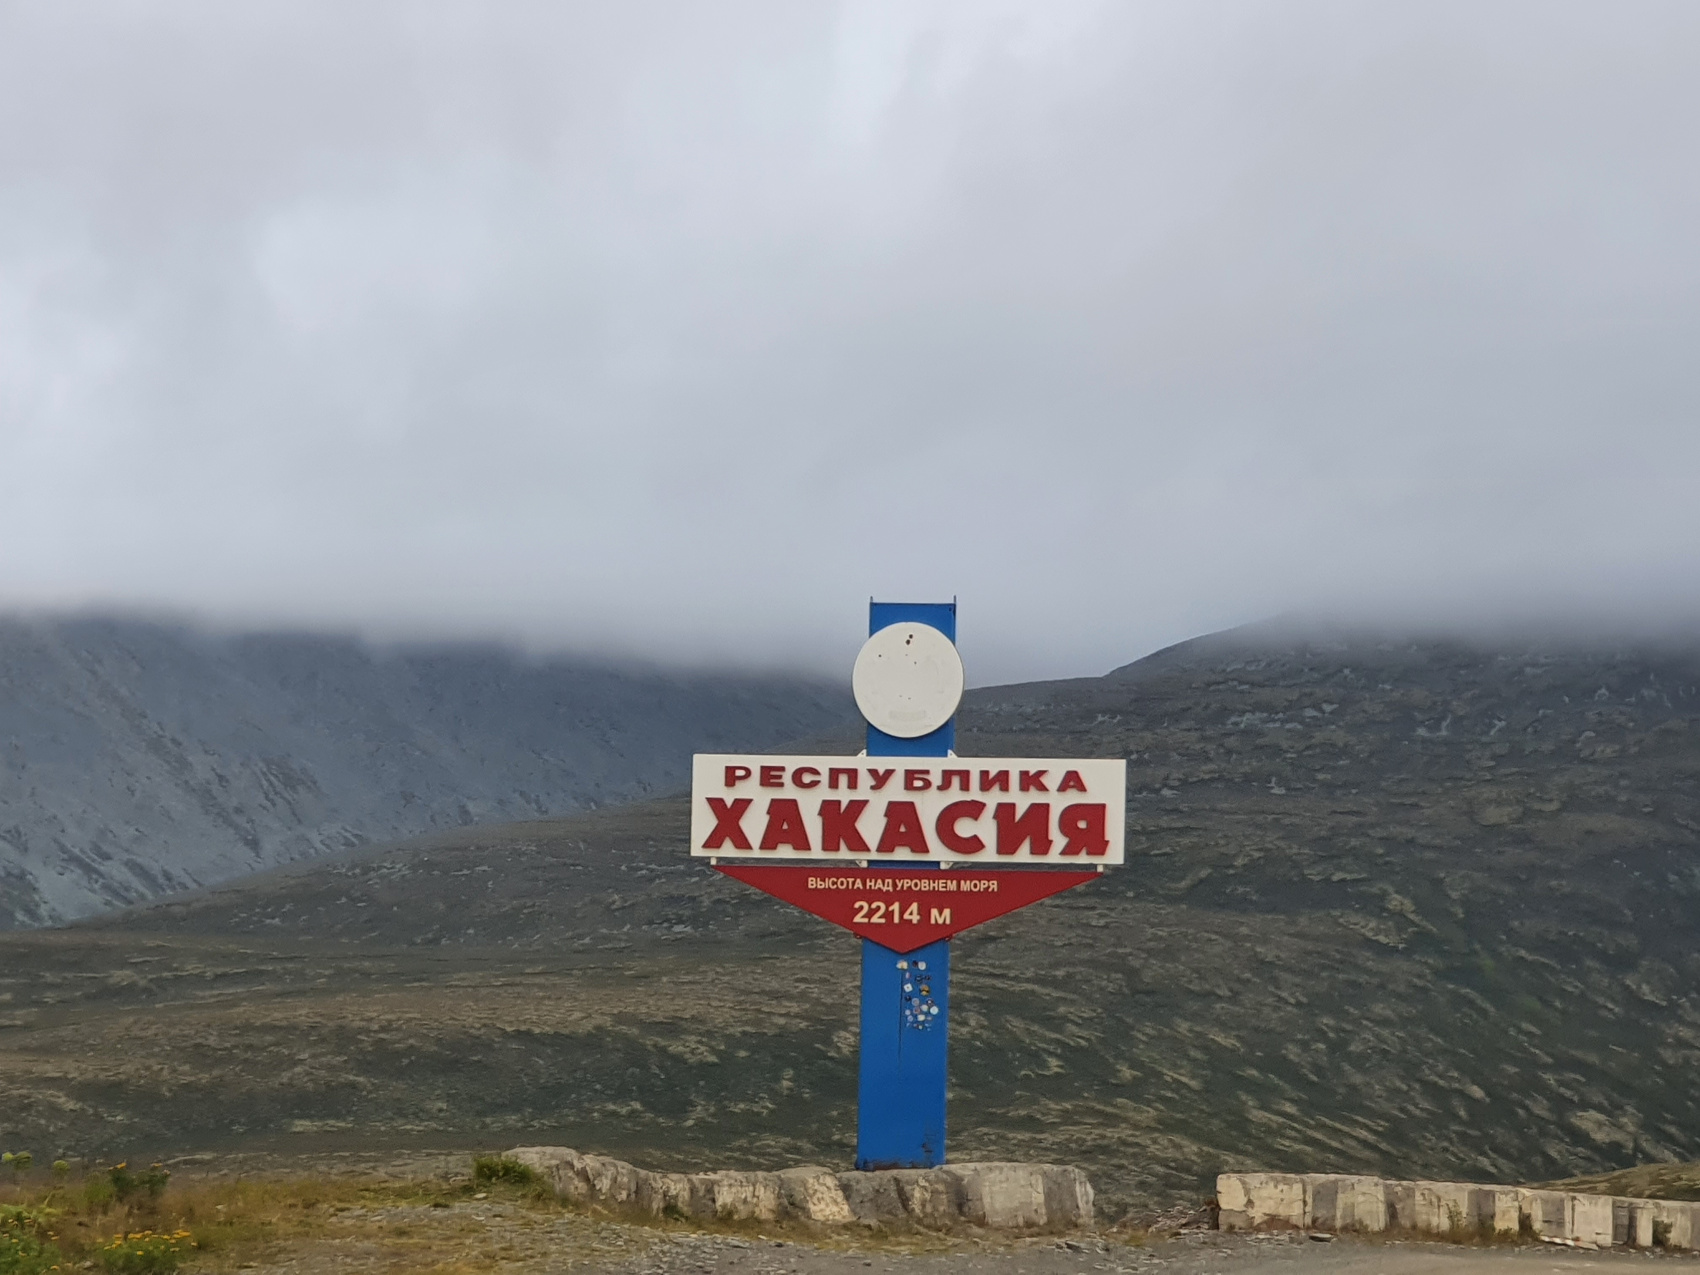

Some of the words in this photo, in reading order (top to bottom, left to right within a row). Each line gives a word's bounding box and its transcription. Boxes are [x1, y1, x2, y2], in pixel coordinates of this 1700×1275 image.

[724, 766, 1088, 792] РЕСПУБЛИКА
[702, 798, 1109, 855] ХАКАСИЯ
[808, 877, 863, 890] ВЫСОТА
[866, 878, 893, 892] НАД
[895, 879, 957, 892] УРОВНЕМ
[960, 880, 998, 892] МОРЯ
[853, 901, 920, 924] 2214
